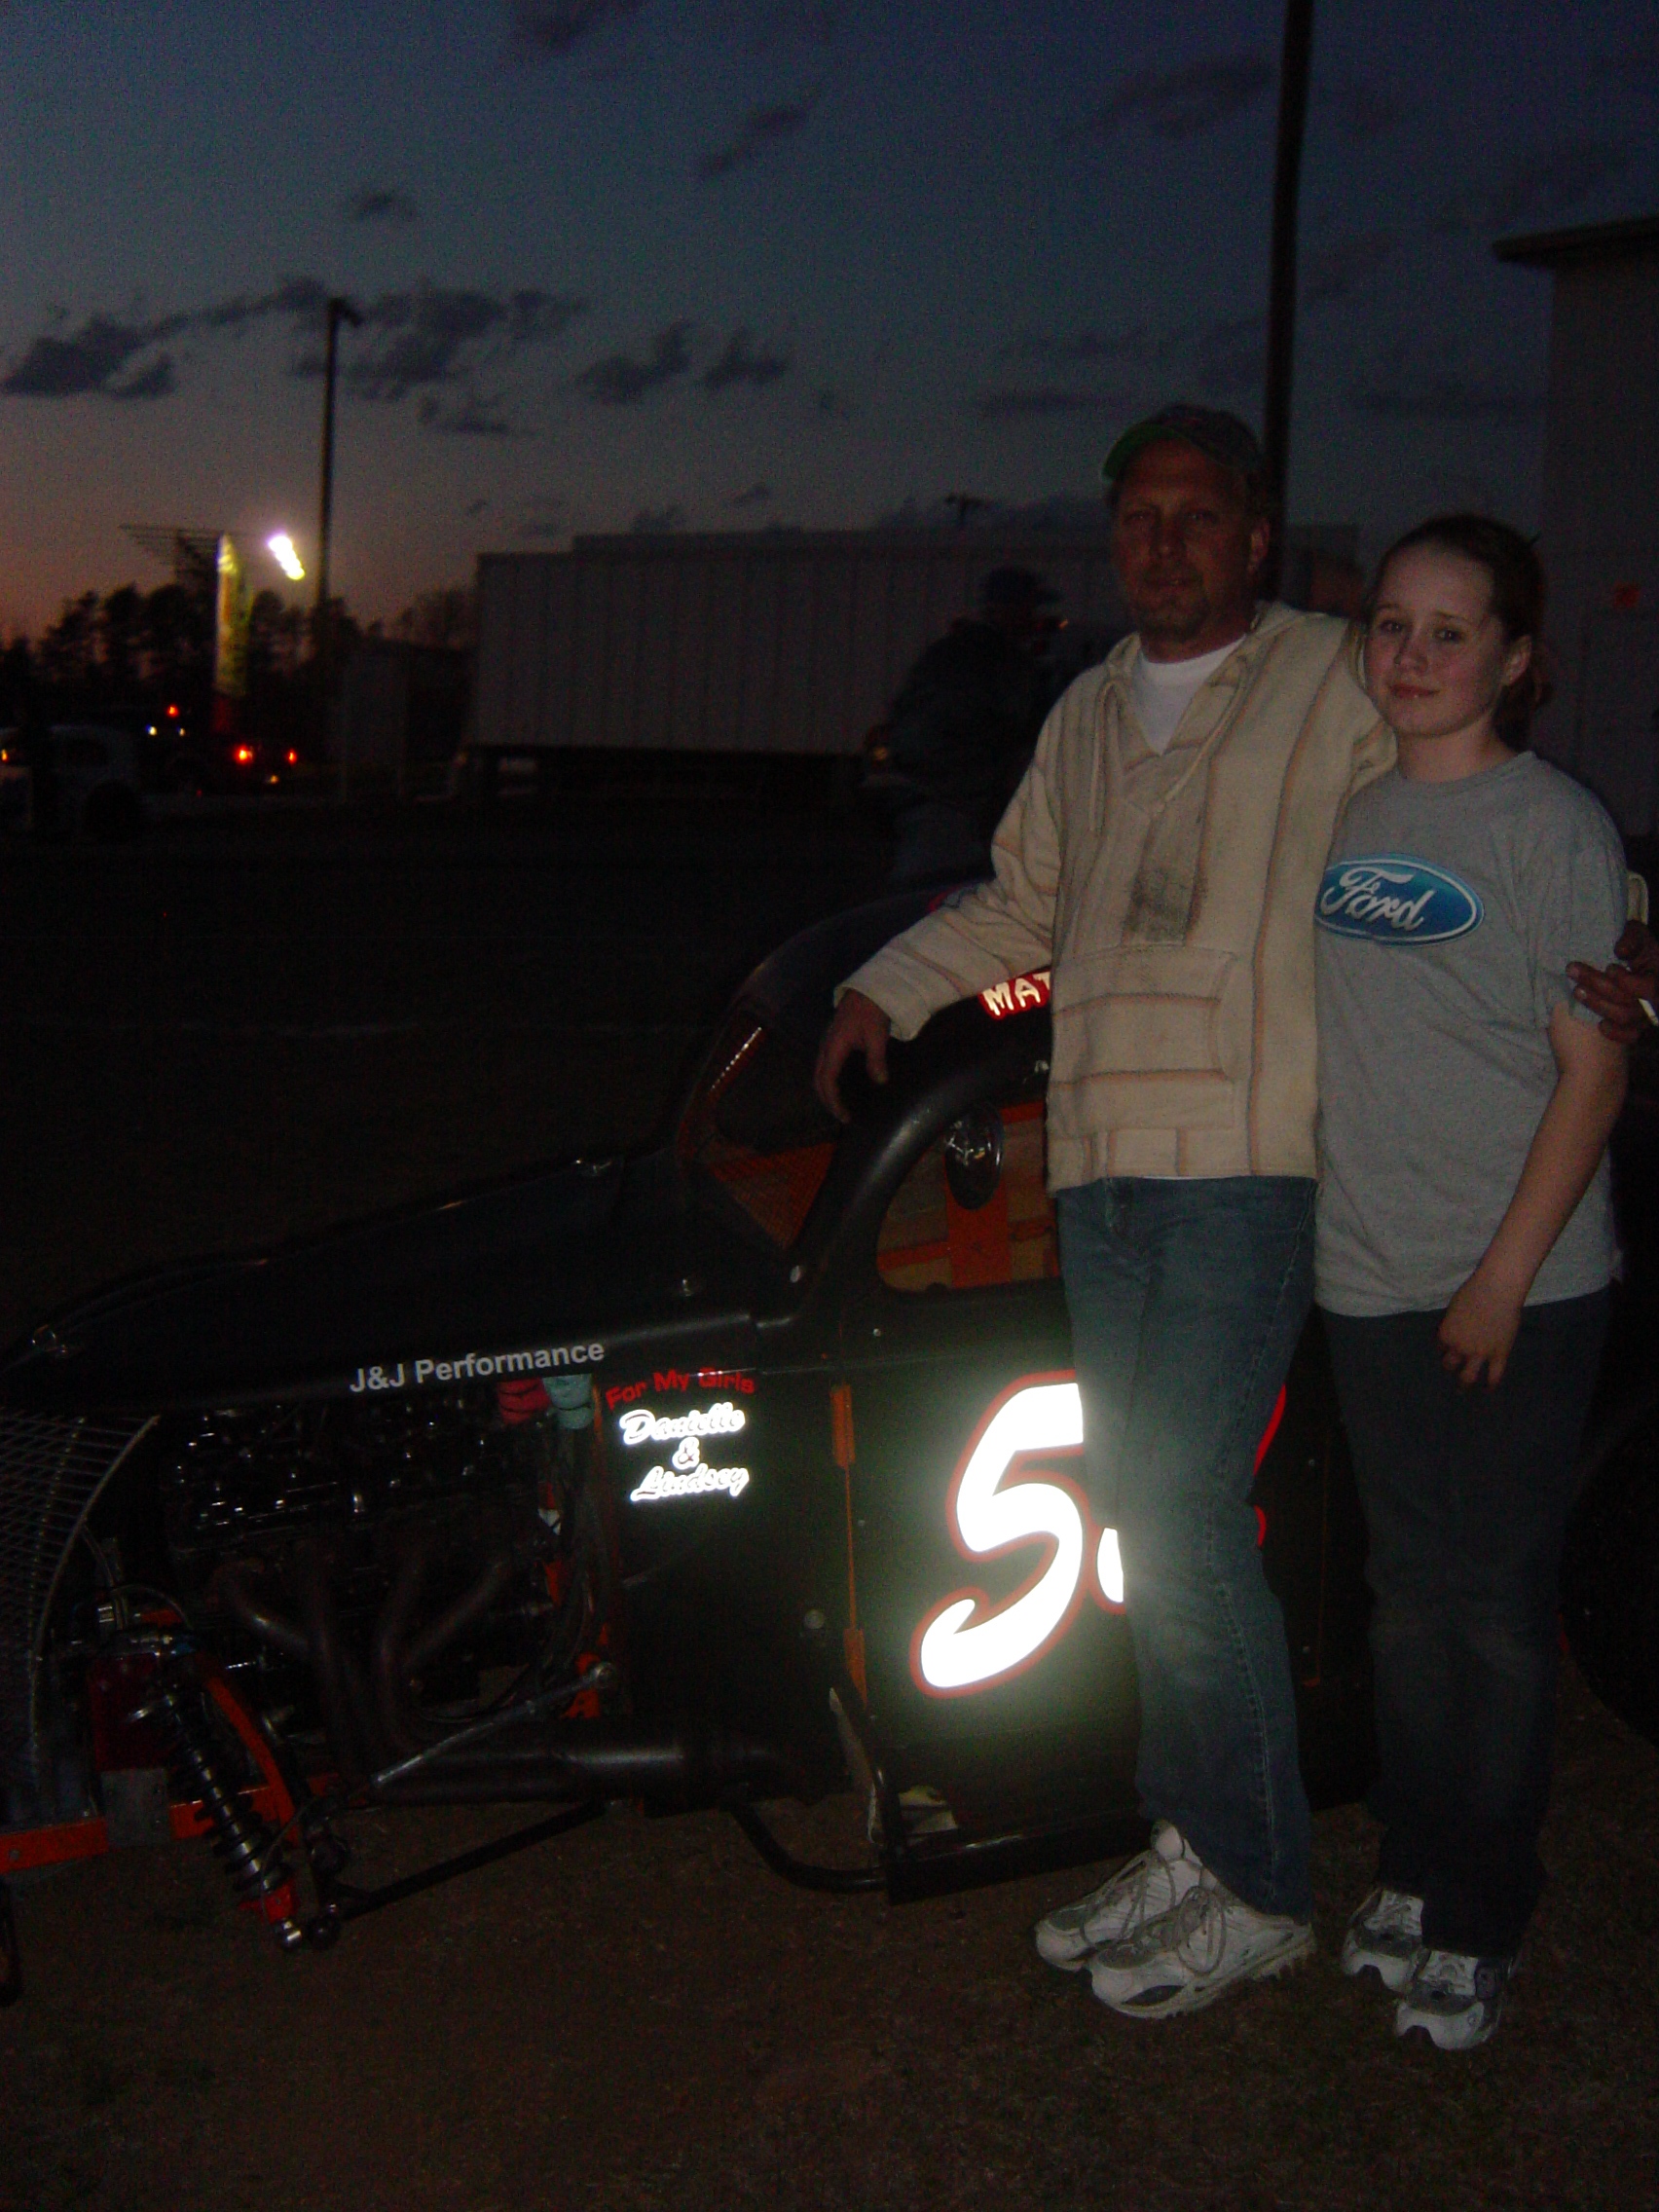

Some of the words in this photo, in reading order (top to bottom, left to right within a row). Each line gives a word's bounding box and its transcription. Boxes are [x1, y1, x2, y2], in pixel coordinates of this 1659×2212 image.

[1320, 866, 1436, 932] Ford
[350, 1362, 406, 1393] J&J
[415, 1342, 605, 1384] Performance
[605, 1381, 647, 1411] For
[653, 1369, 690, 1392] My
[698, 1367, 756, 1394] Girls
[619, 1402, 746, 1445] Danielle
[672, 1436, 700, 1470] &
[919, 1381, 1125, 1690] 5
